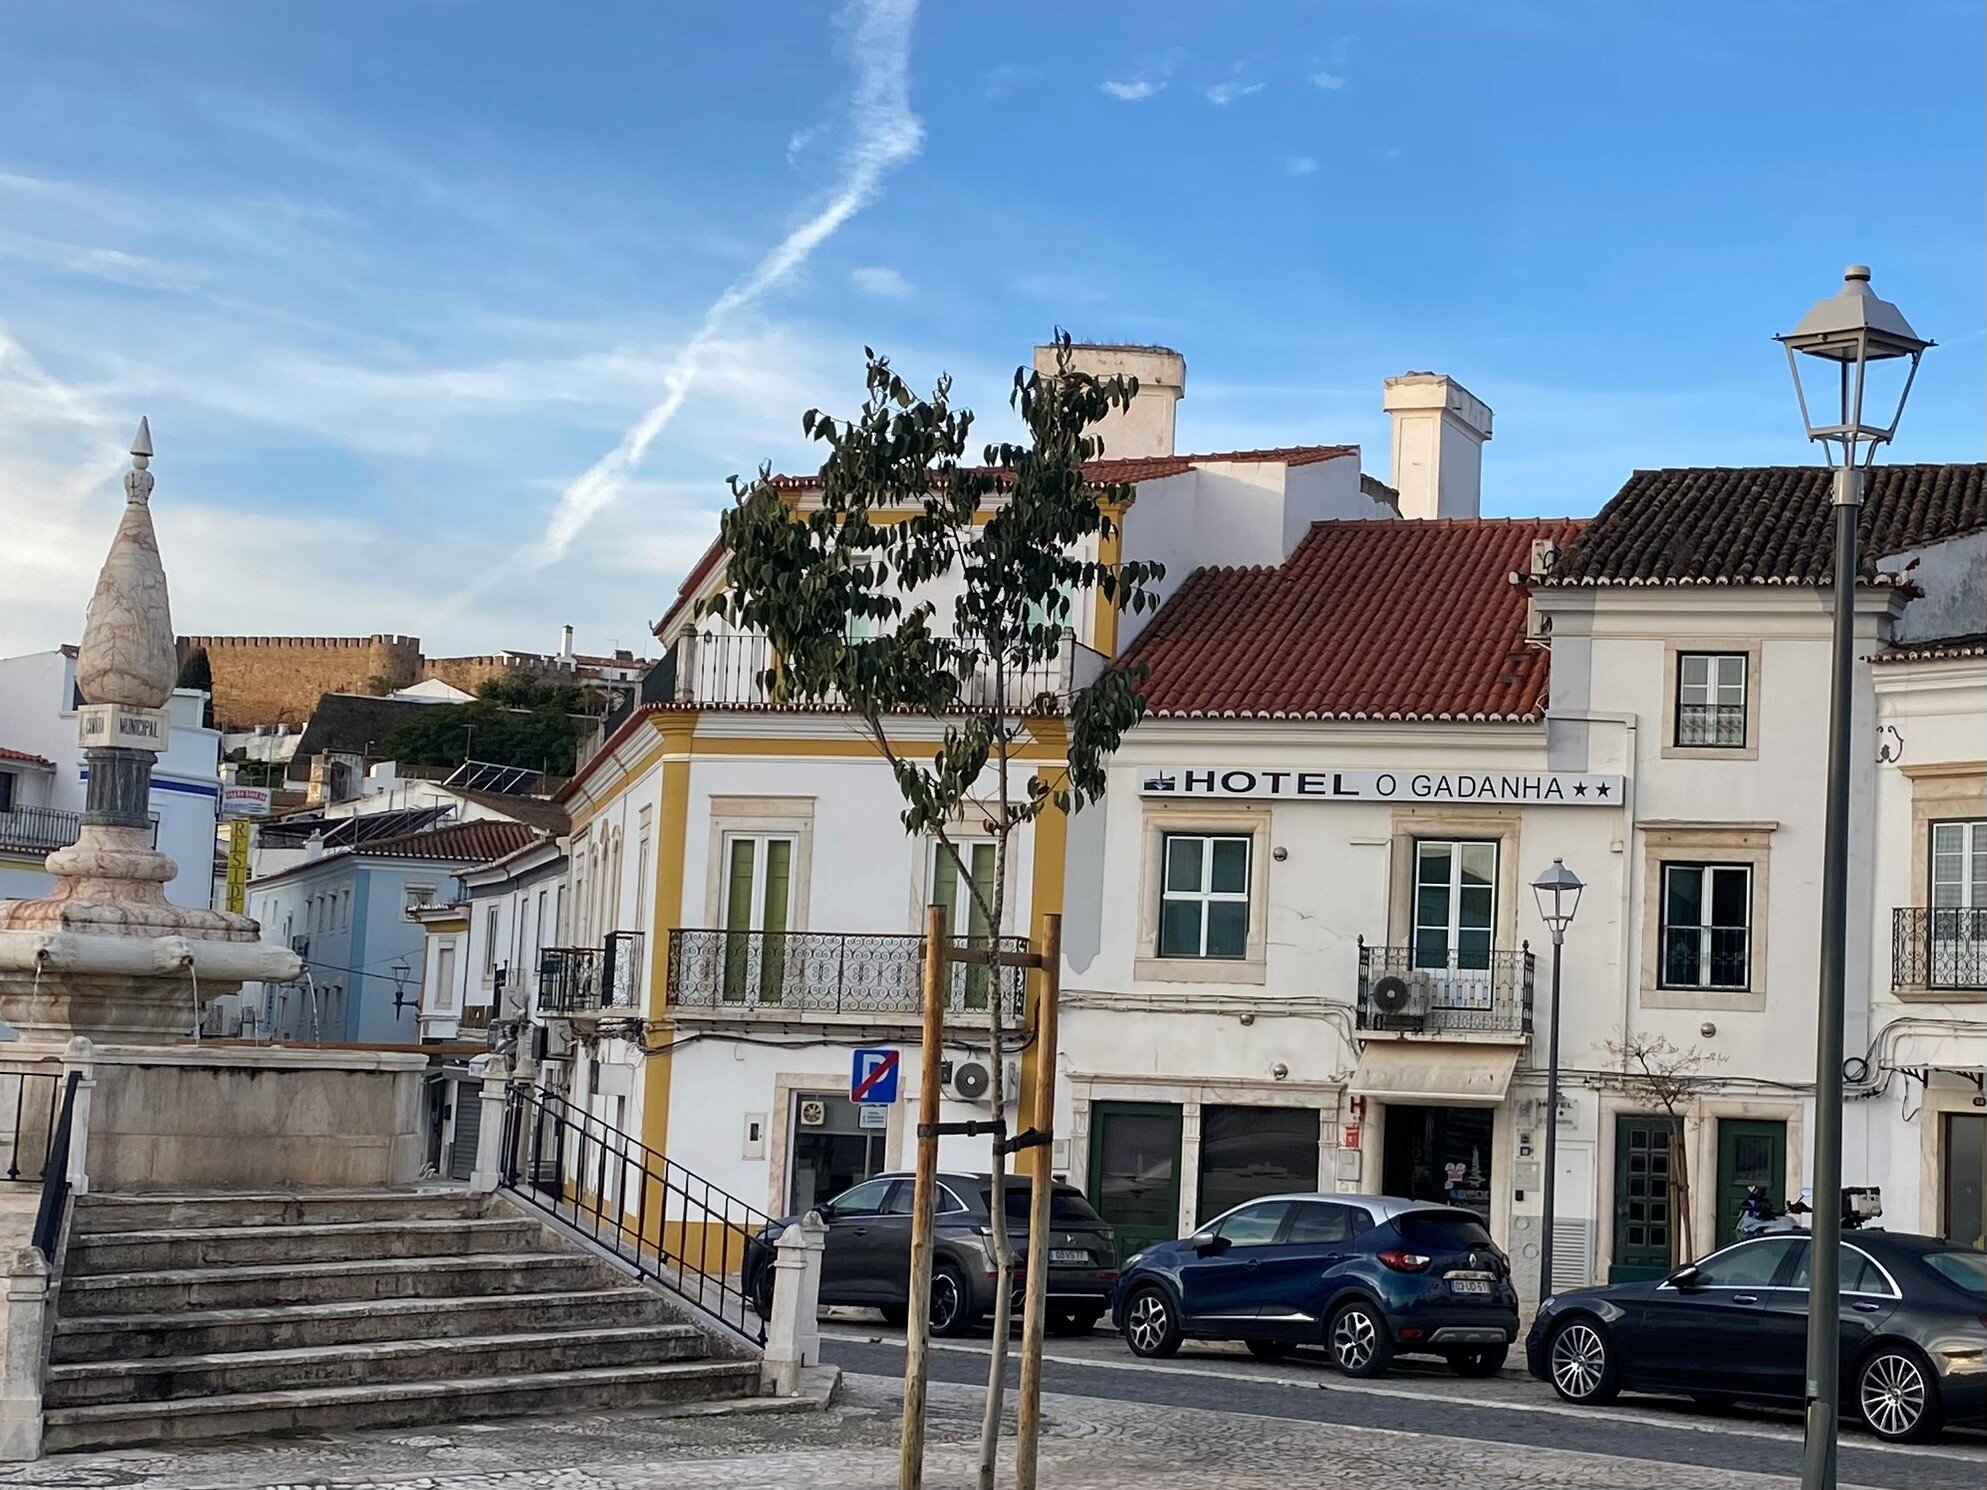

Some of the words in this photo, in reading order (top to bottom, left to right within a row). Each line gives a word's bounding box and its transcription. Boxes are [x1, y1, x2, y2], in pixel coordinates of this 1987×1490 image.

[120, 718, 159, 738] MUNICIPAL
[1185, 771, 1359, 796] HOTEL
[1376, 774, 1397, 796] O
[1411, 775, 1564, 799] GADANHA
